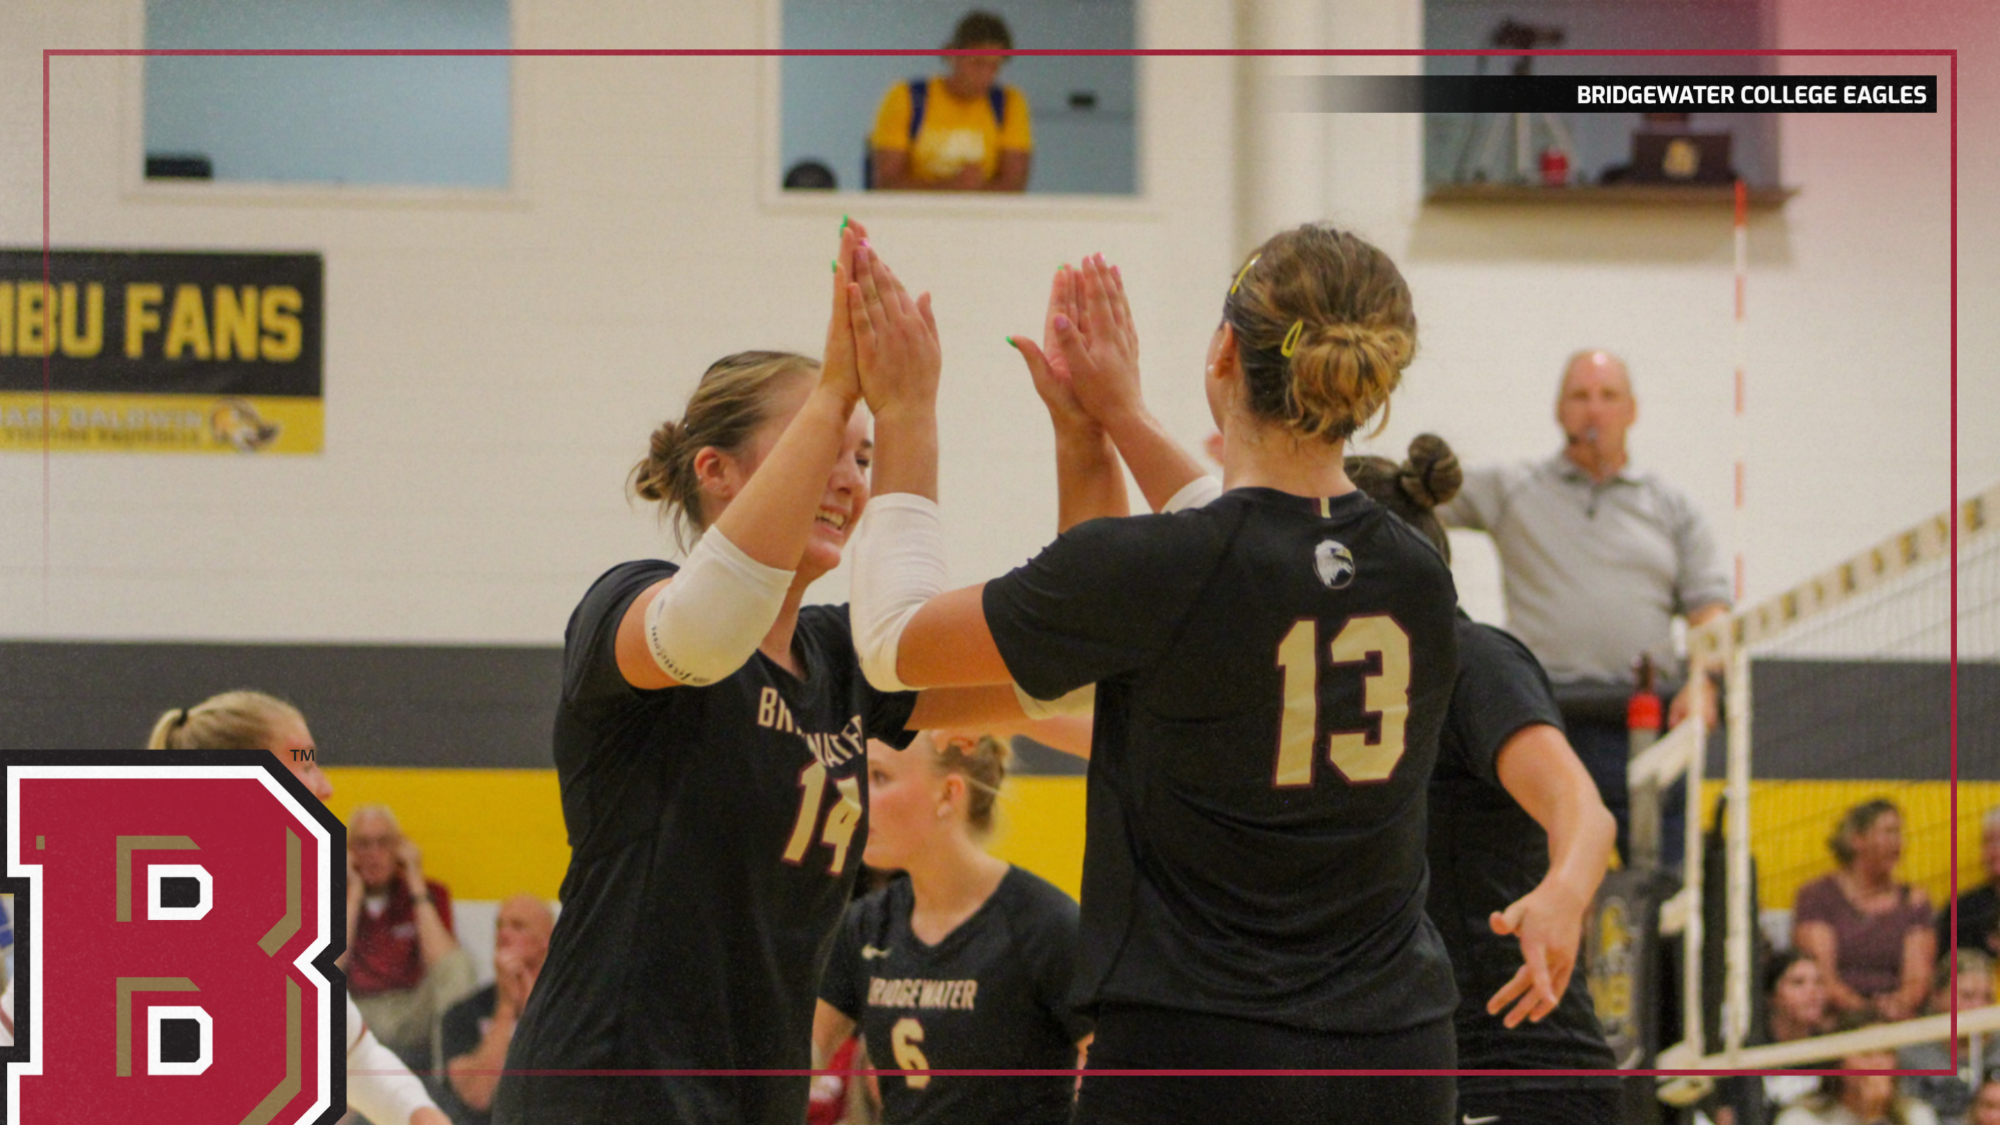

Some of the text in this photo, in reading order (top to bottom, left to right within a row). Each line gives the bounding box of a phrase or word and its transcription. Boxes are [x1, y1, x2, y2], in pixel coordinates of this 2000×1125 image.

[125, 283, 303, 362] FANS
[1274, 615, 1411, 787] 13
[782, 760, 864, 876] 14
[890, 1017, 932, 1090] 6
